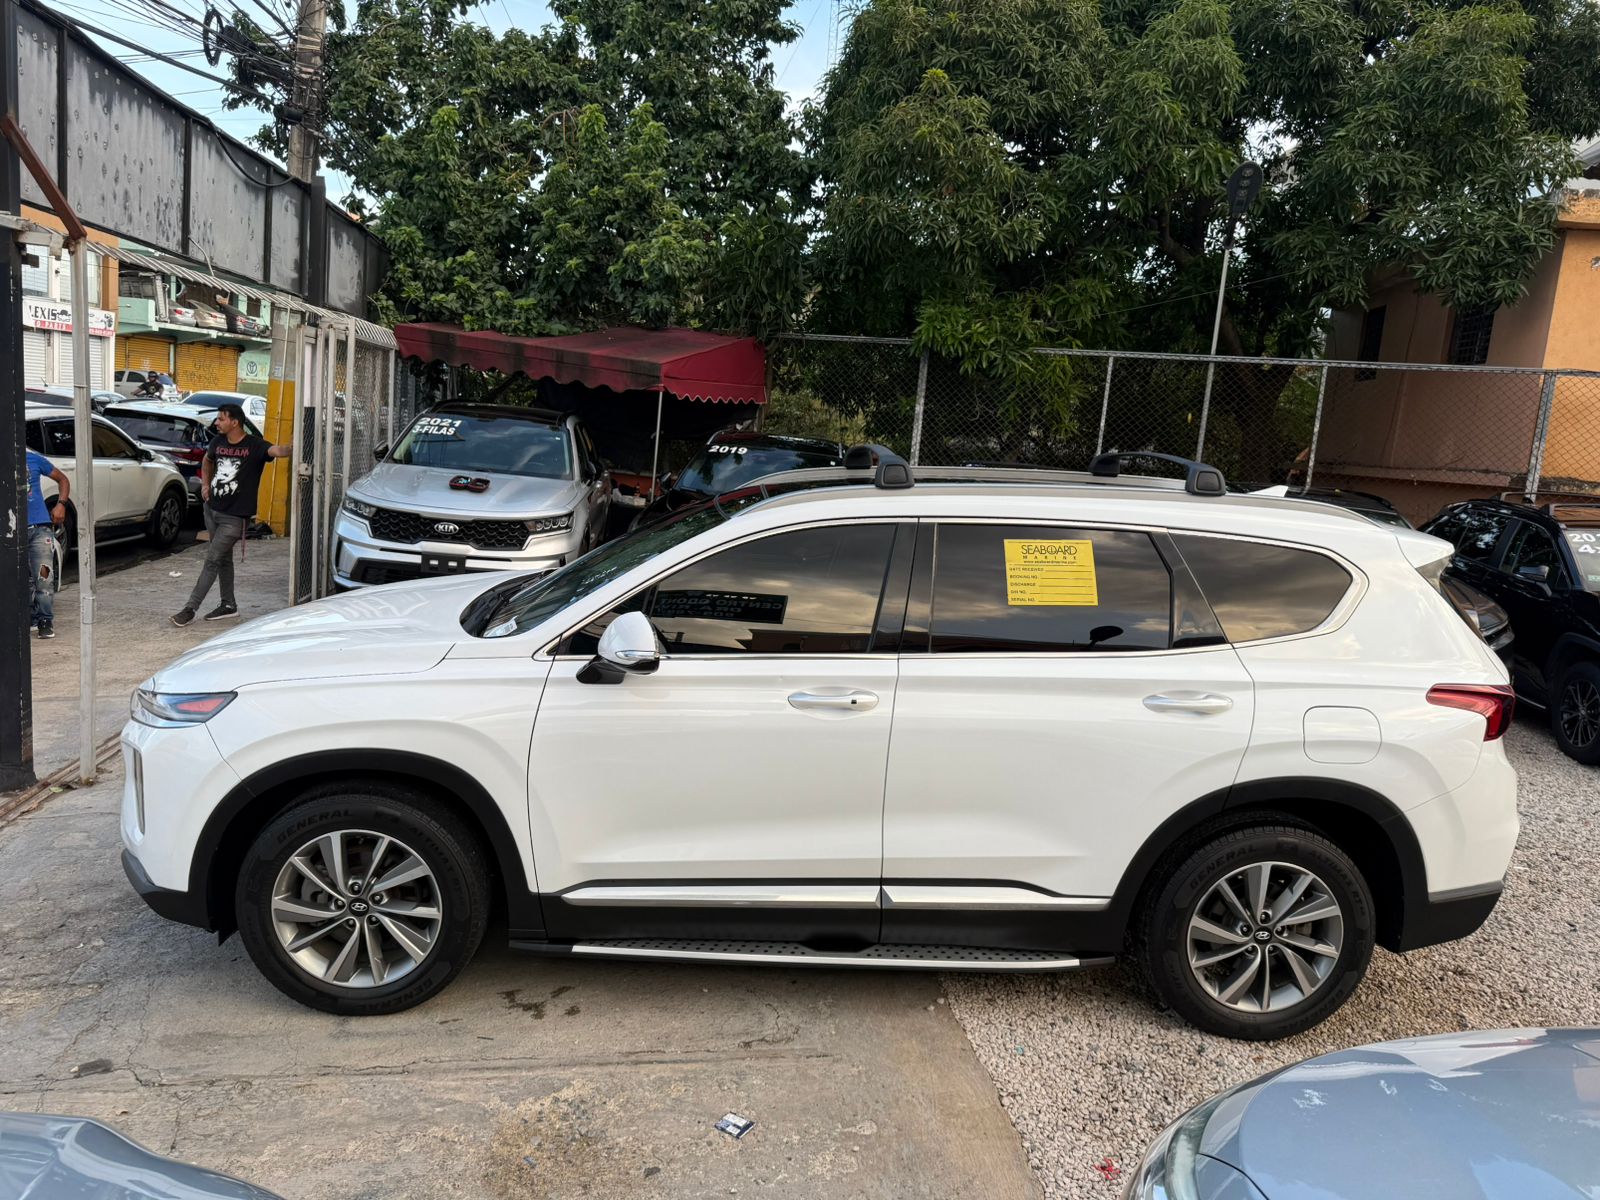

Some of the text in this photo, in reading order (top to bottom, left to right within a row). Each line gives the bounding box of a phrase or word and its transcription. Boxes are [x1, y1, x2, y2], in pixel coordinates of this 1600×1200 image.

[417, 417, 462, 427] 2021
[412, 425, 456, 436] 3-FILAS
[216, 446, 249, 457] SCREAM
[708, 445, 748, 455] 2019
[1021, 544, 1078, 555] SEABOARD
[277, 809, 353, 844] GENERAL
[1190, 844, 1259, 889] GENERAL
